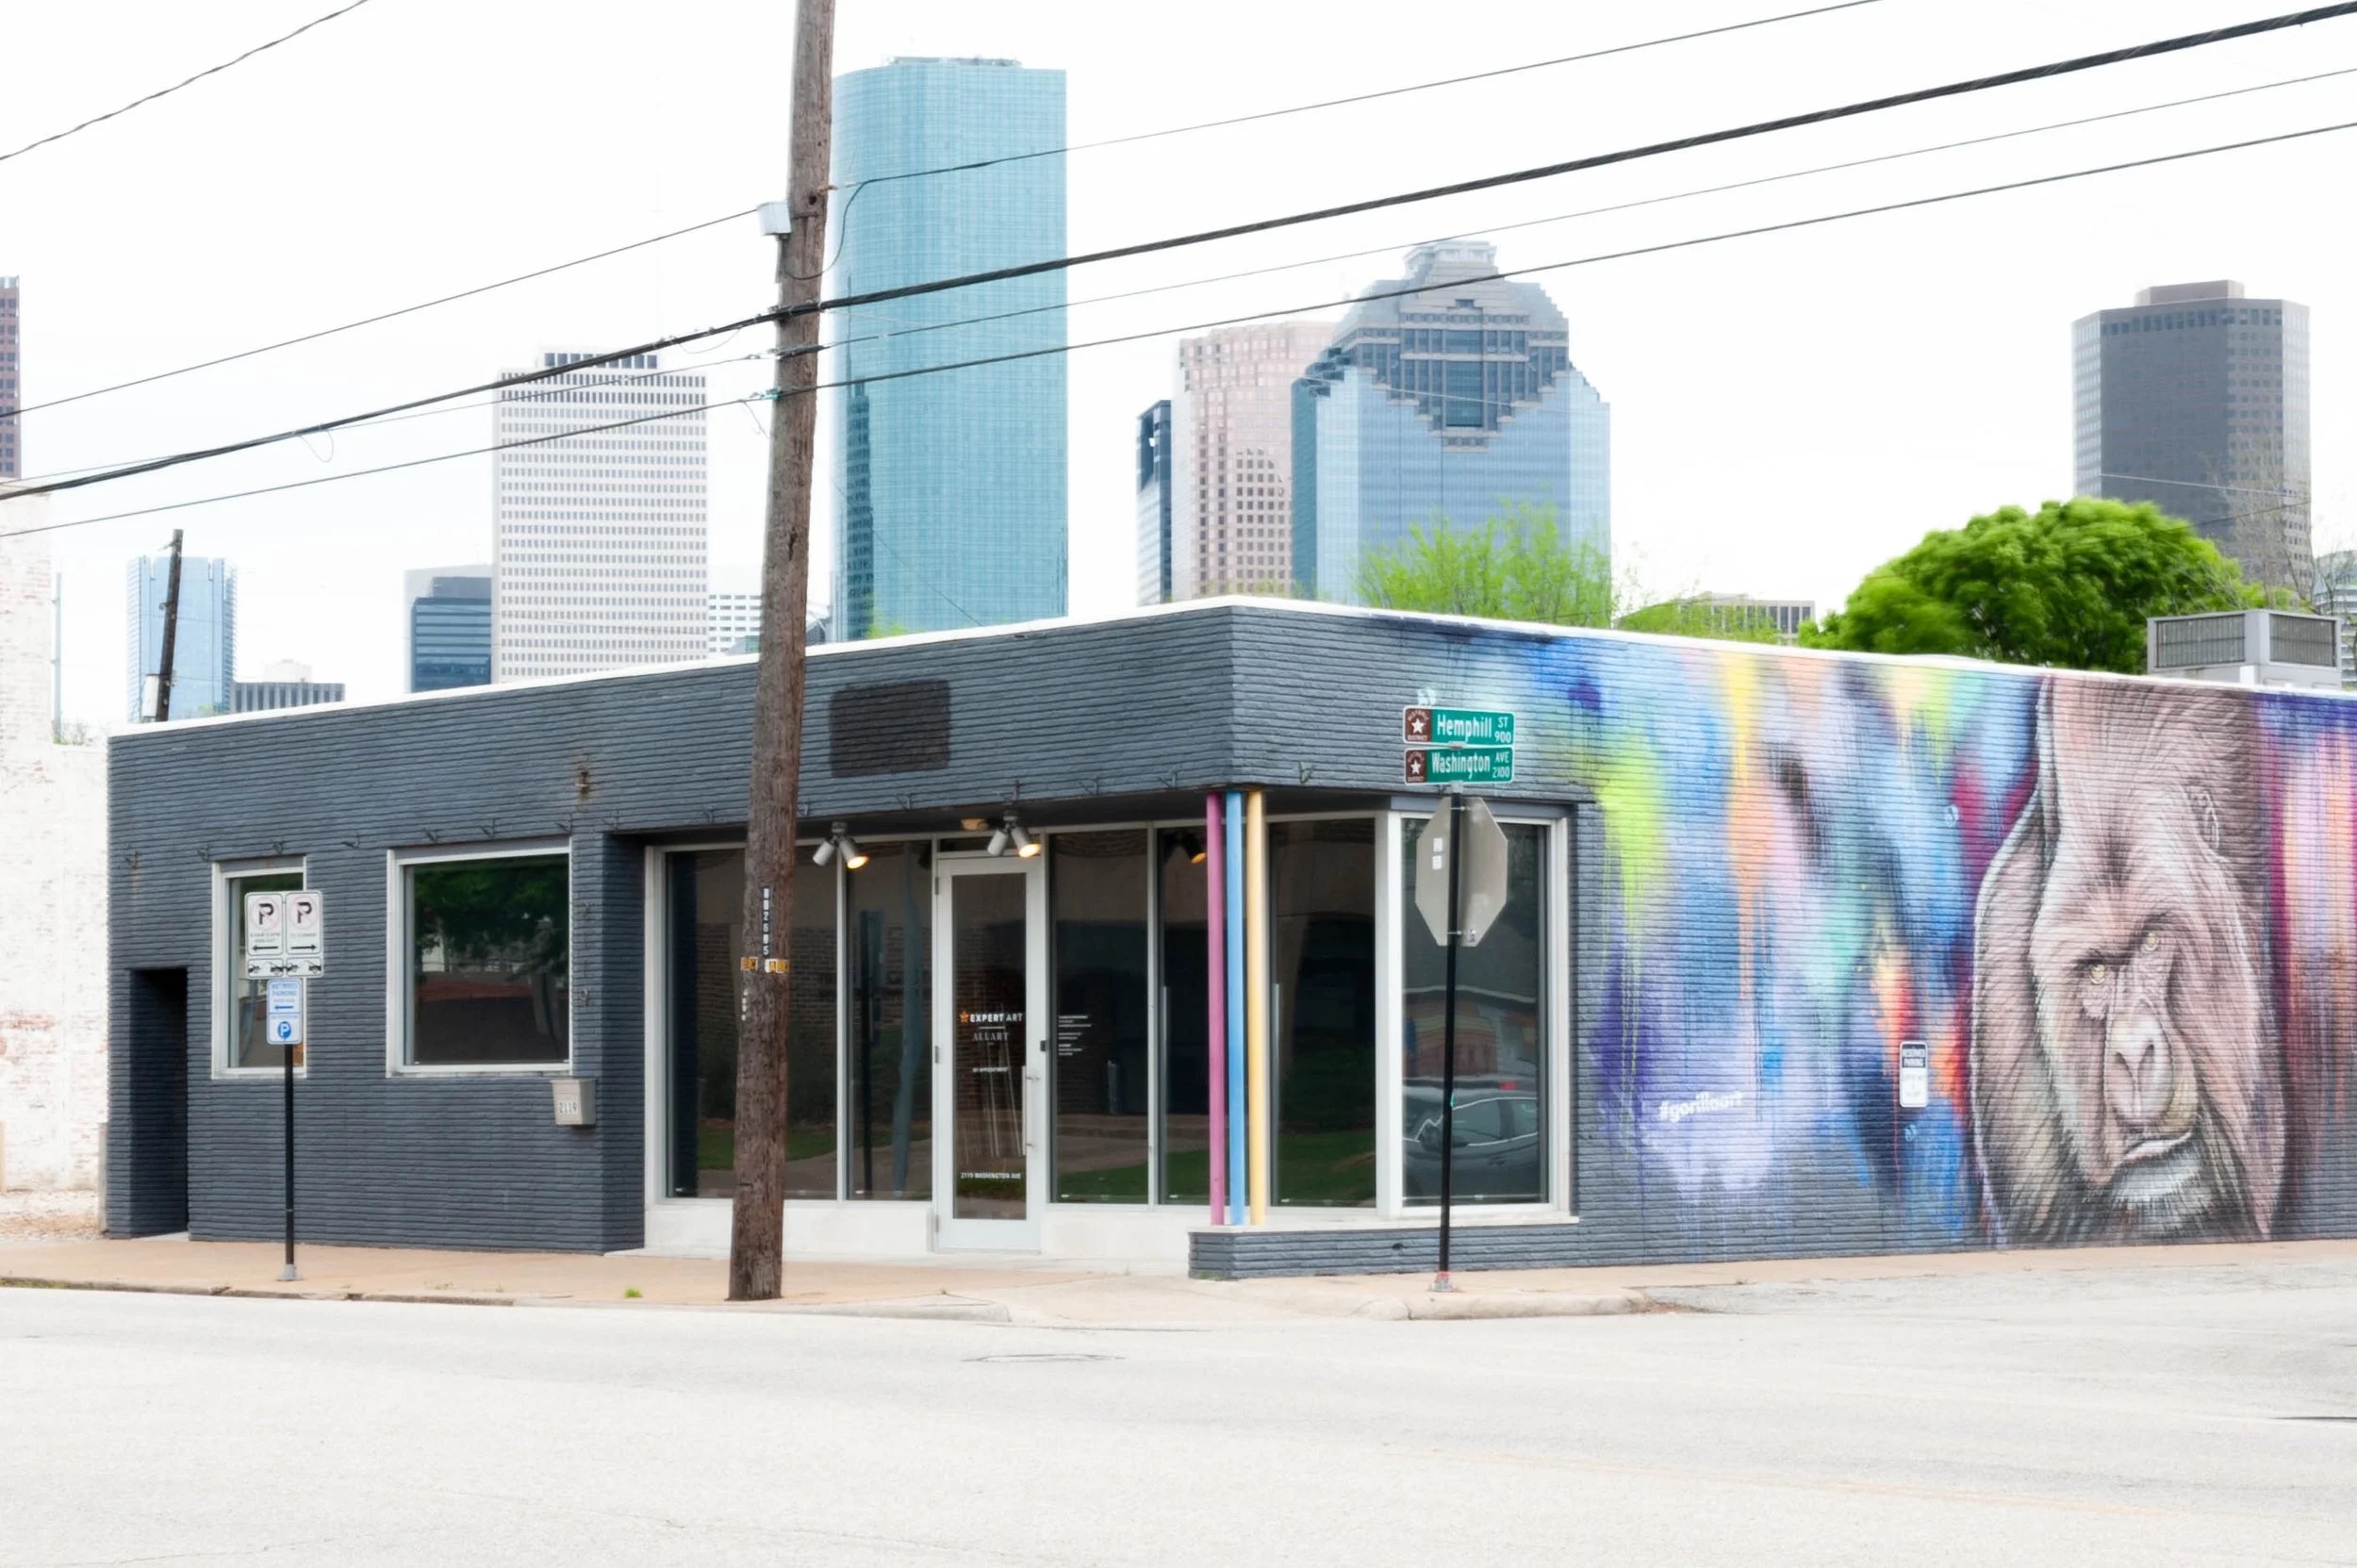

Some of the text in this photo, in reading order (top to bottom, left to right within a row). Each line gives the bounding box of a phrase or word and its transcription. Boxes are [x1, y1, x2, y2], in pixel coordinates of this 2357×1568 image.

[1437, 714, 1508, 743] Hemphill ST
[1494, 732, 1511, 743] 900
[1431, 751, 1509, 780] Washington AVE
[1492, 767, 1510, 778] 2100
[970, 1013, 1023, 1023] EXPERT ART
[558, 1101, 578, 1114] 2119
